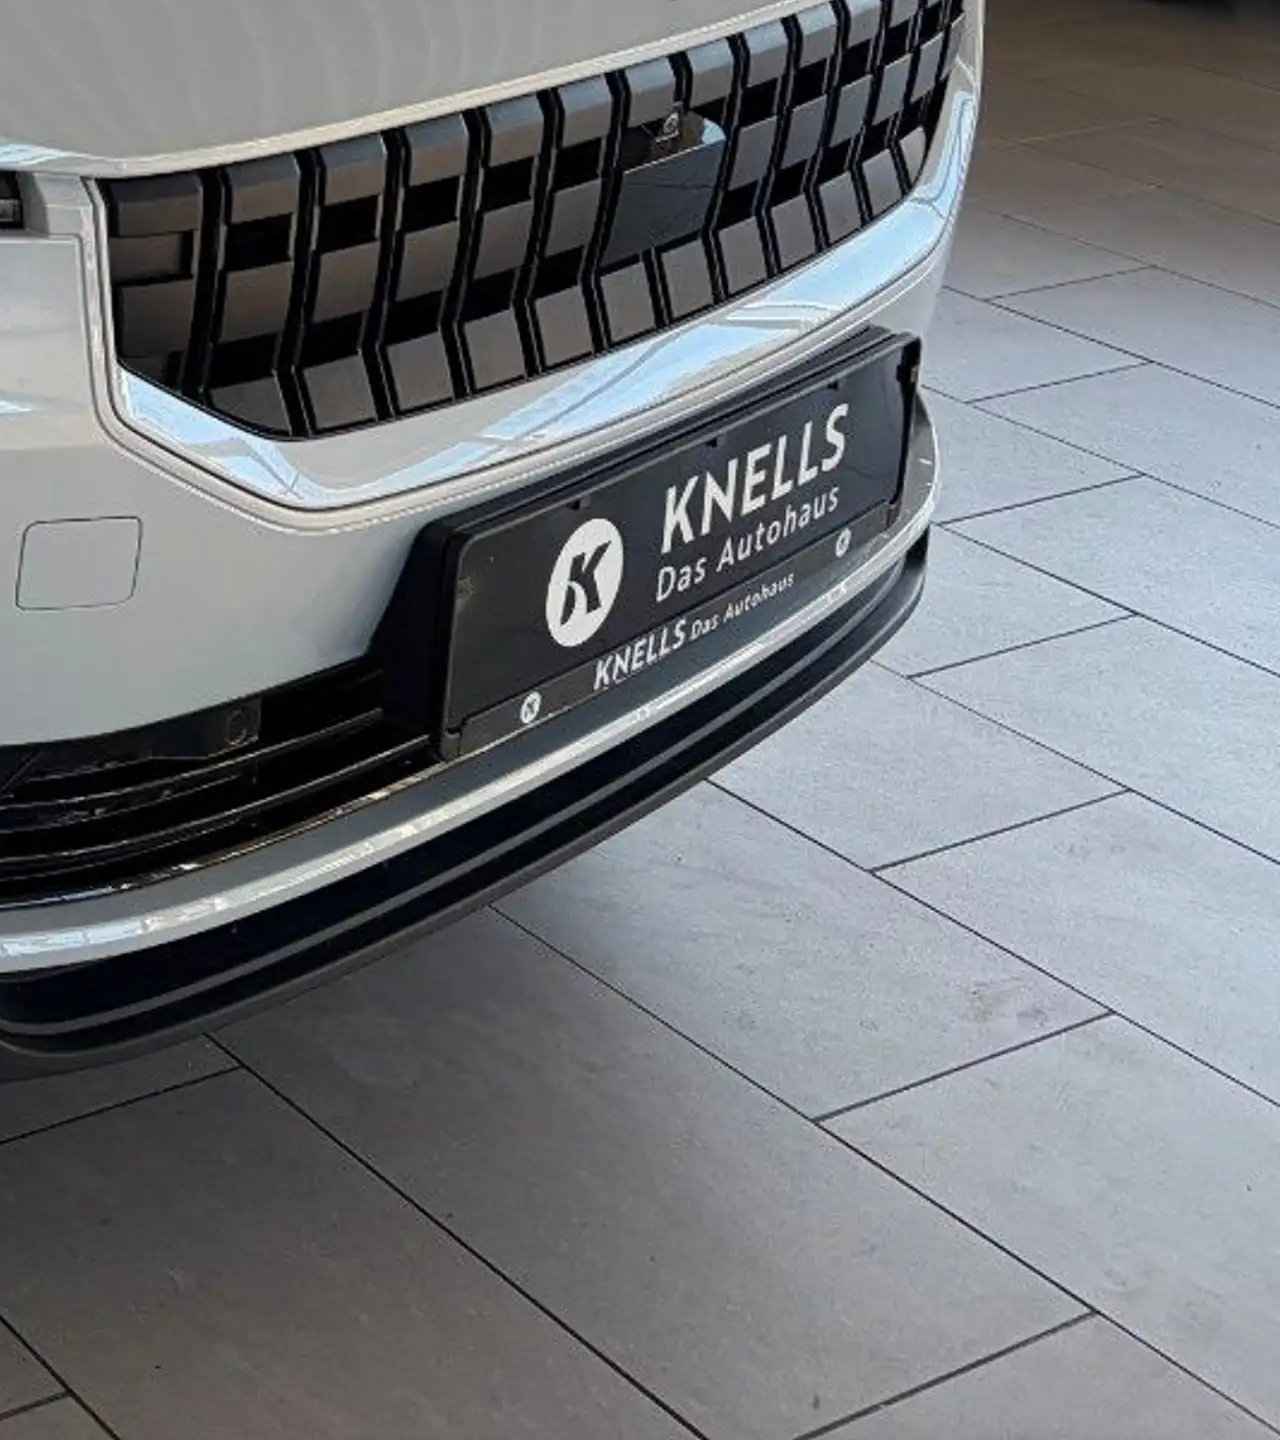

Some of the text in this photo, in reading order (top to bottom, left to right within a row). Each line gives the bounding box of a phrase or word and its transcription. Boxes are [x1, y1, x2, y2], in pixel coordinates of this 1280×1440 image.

[660, 403, 849, 555] KNELLS
[656, 557, 707, 602] Das
[715, 486, 839, 573] Autohaus
[594, 573, 794, 691] KNELLS Das Autohaus
